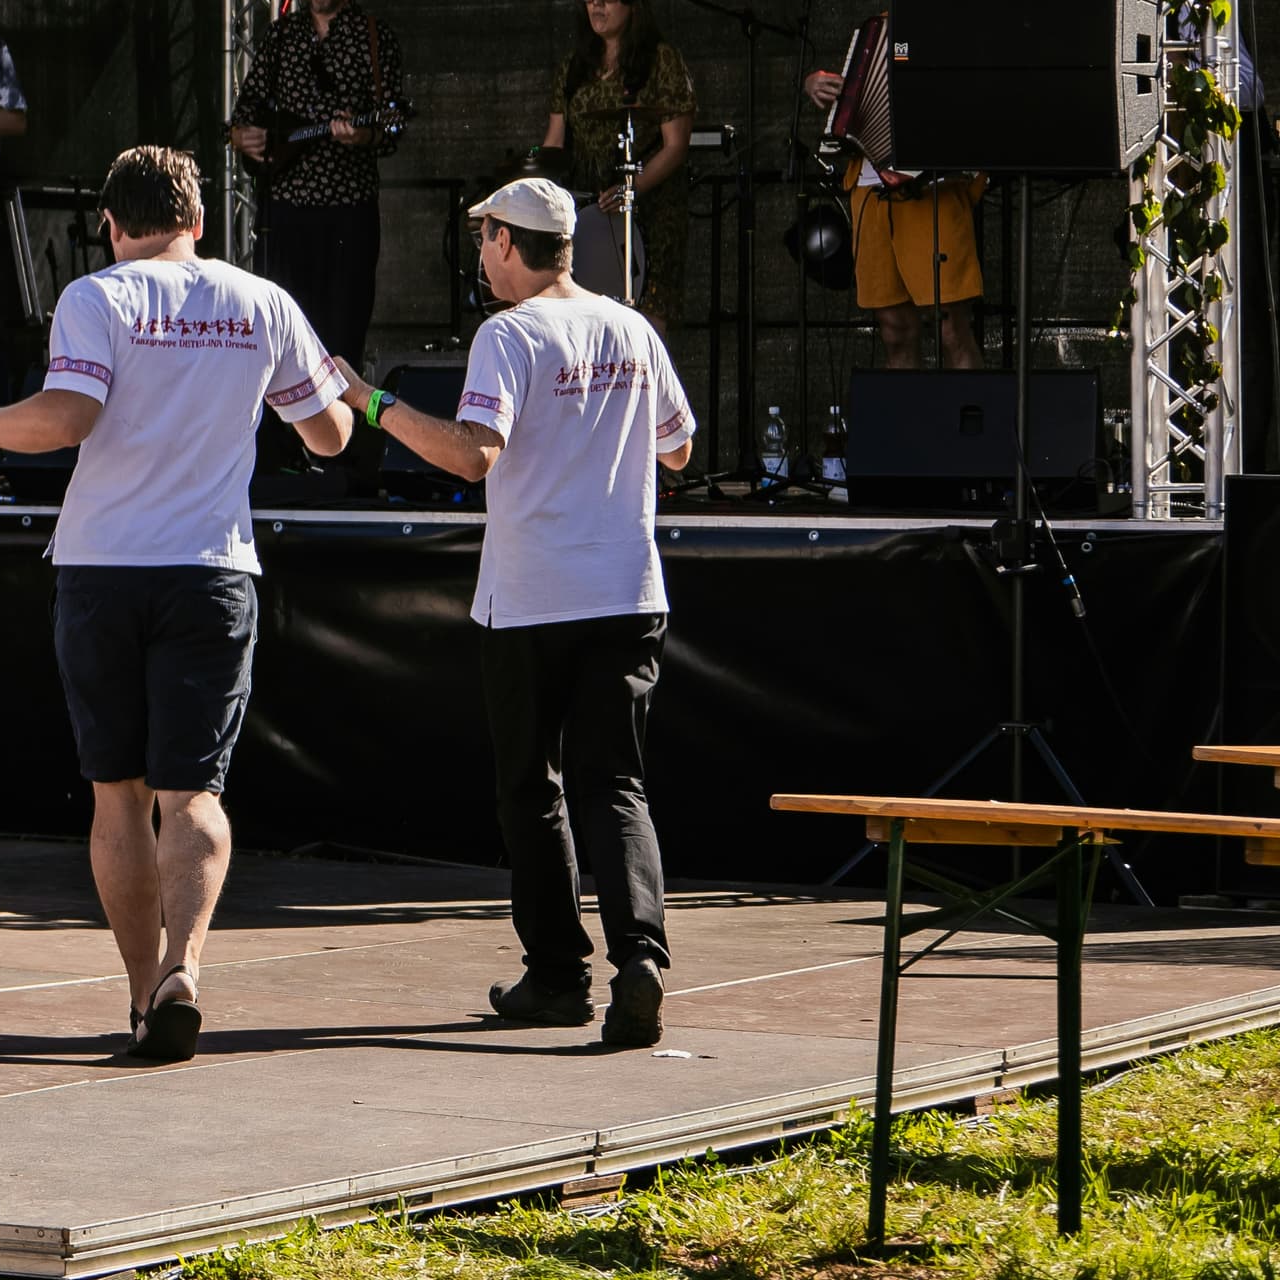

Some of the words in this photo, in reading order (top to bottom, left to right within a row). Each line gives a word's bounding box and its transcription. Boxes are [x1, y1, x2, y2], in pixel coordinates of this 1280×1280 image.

[129, 335, 177, 348] Tanzgruppe
[179, 337, 223, 349] DETELINA
[225, 338, 258, 351] Dresden
